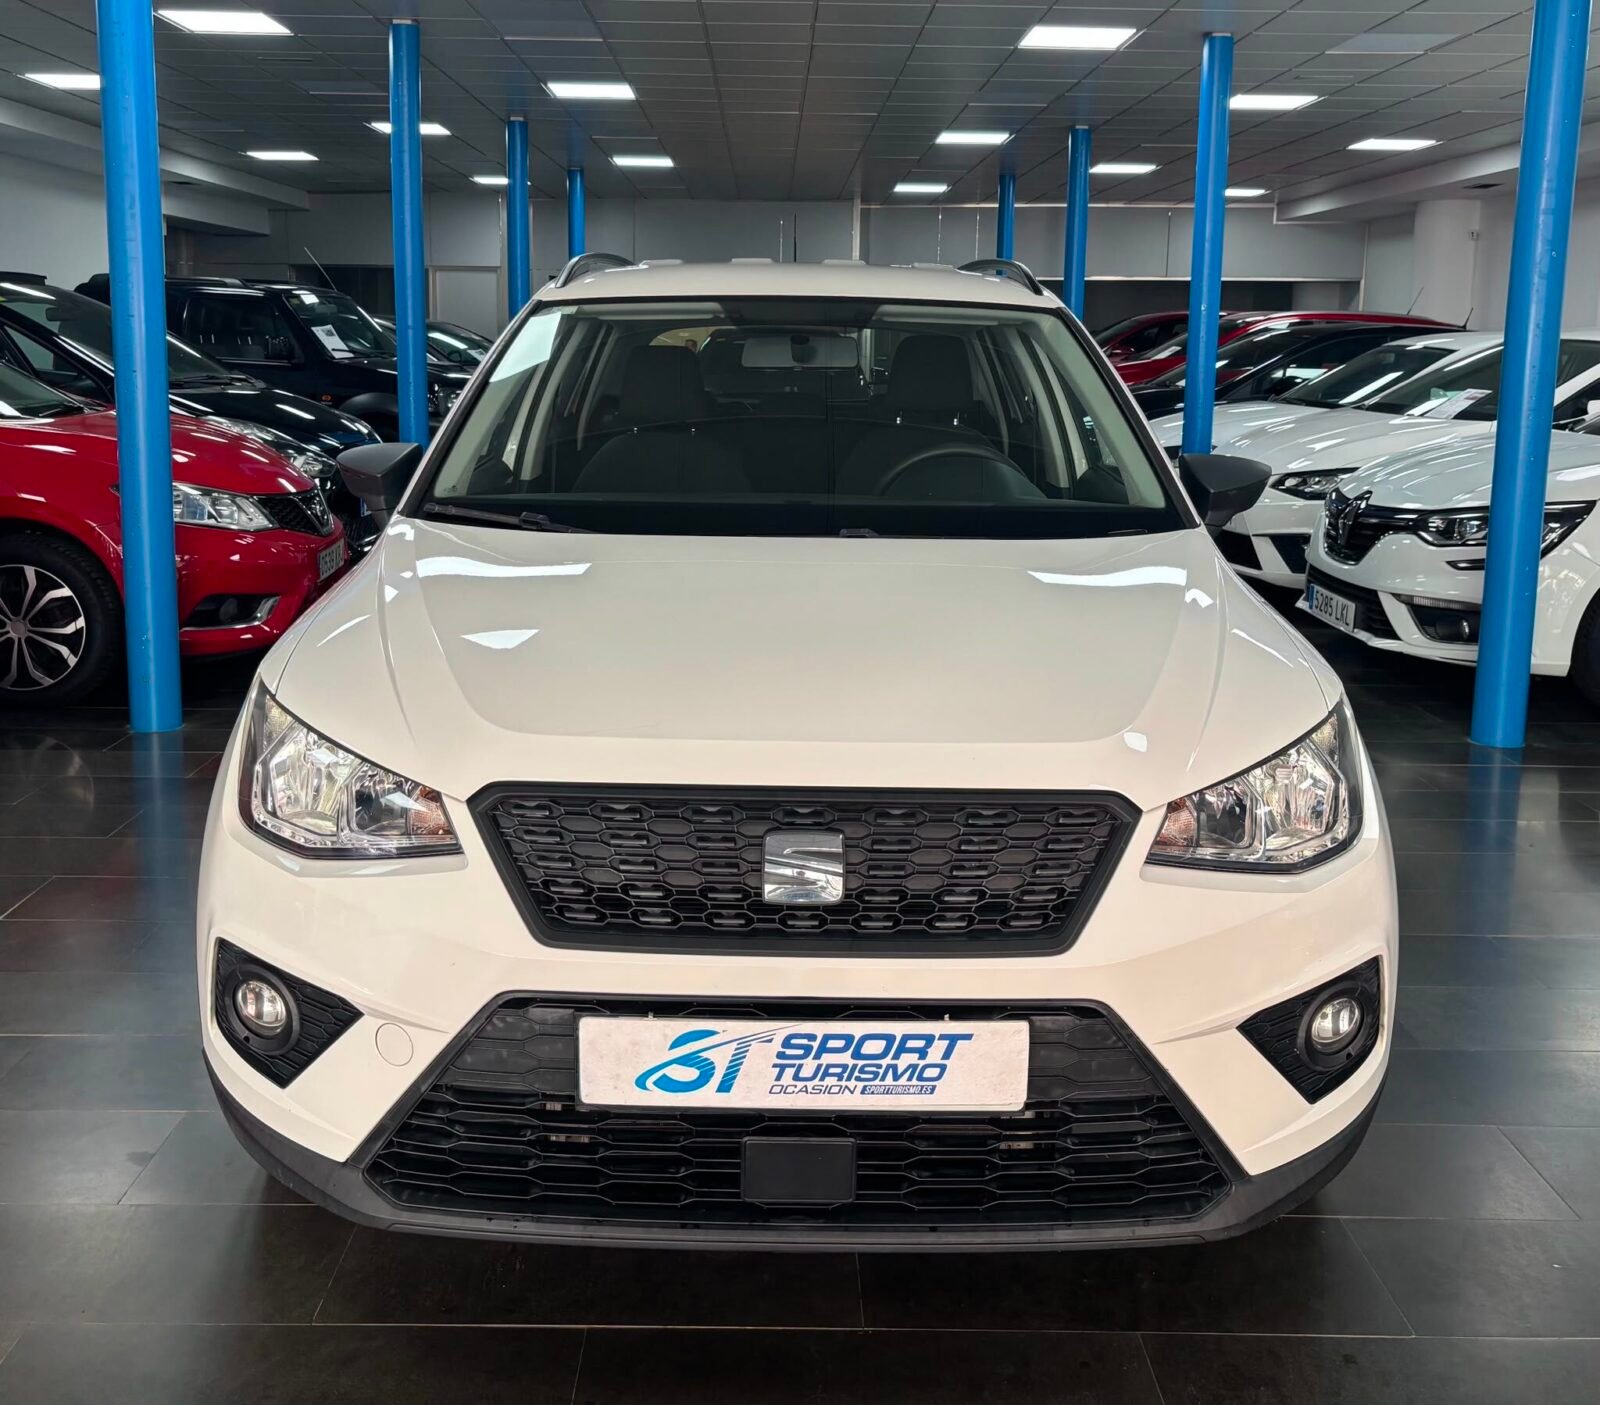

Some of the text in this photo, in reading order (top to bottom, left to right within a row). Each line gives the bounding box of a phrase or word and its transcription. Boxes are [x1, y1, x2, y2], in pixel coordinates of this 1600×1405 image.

[1314, 590, 1350, 627] 5285 LKL
[775, 1032, 975, 1061] SPORT
[771, 1063, 948, 1083] TURISMO
[768, 1084, 935, 1095] OCASION SPORTTURISMO.ES
